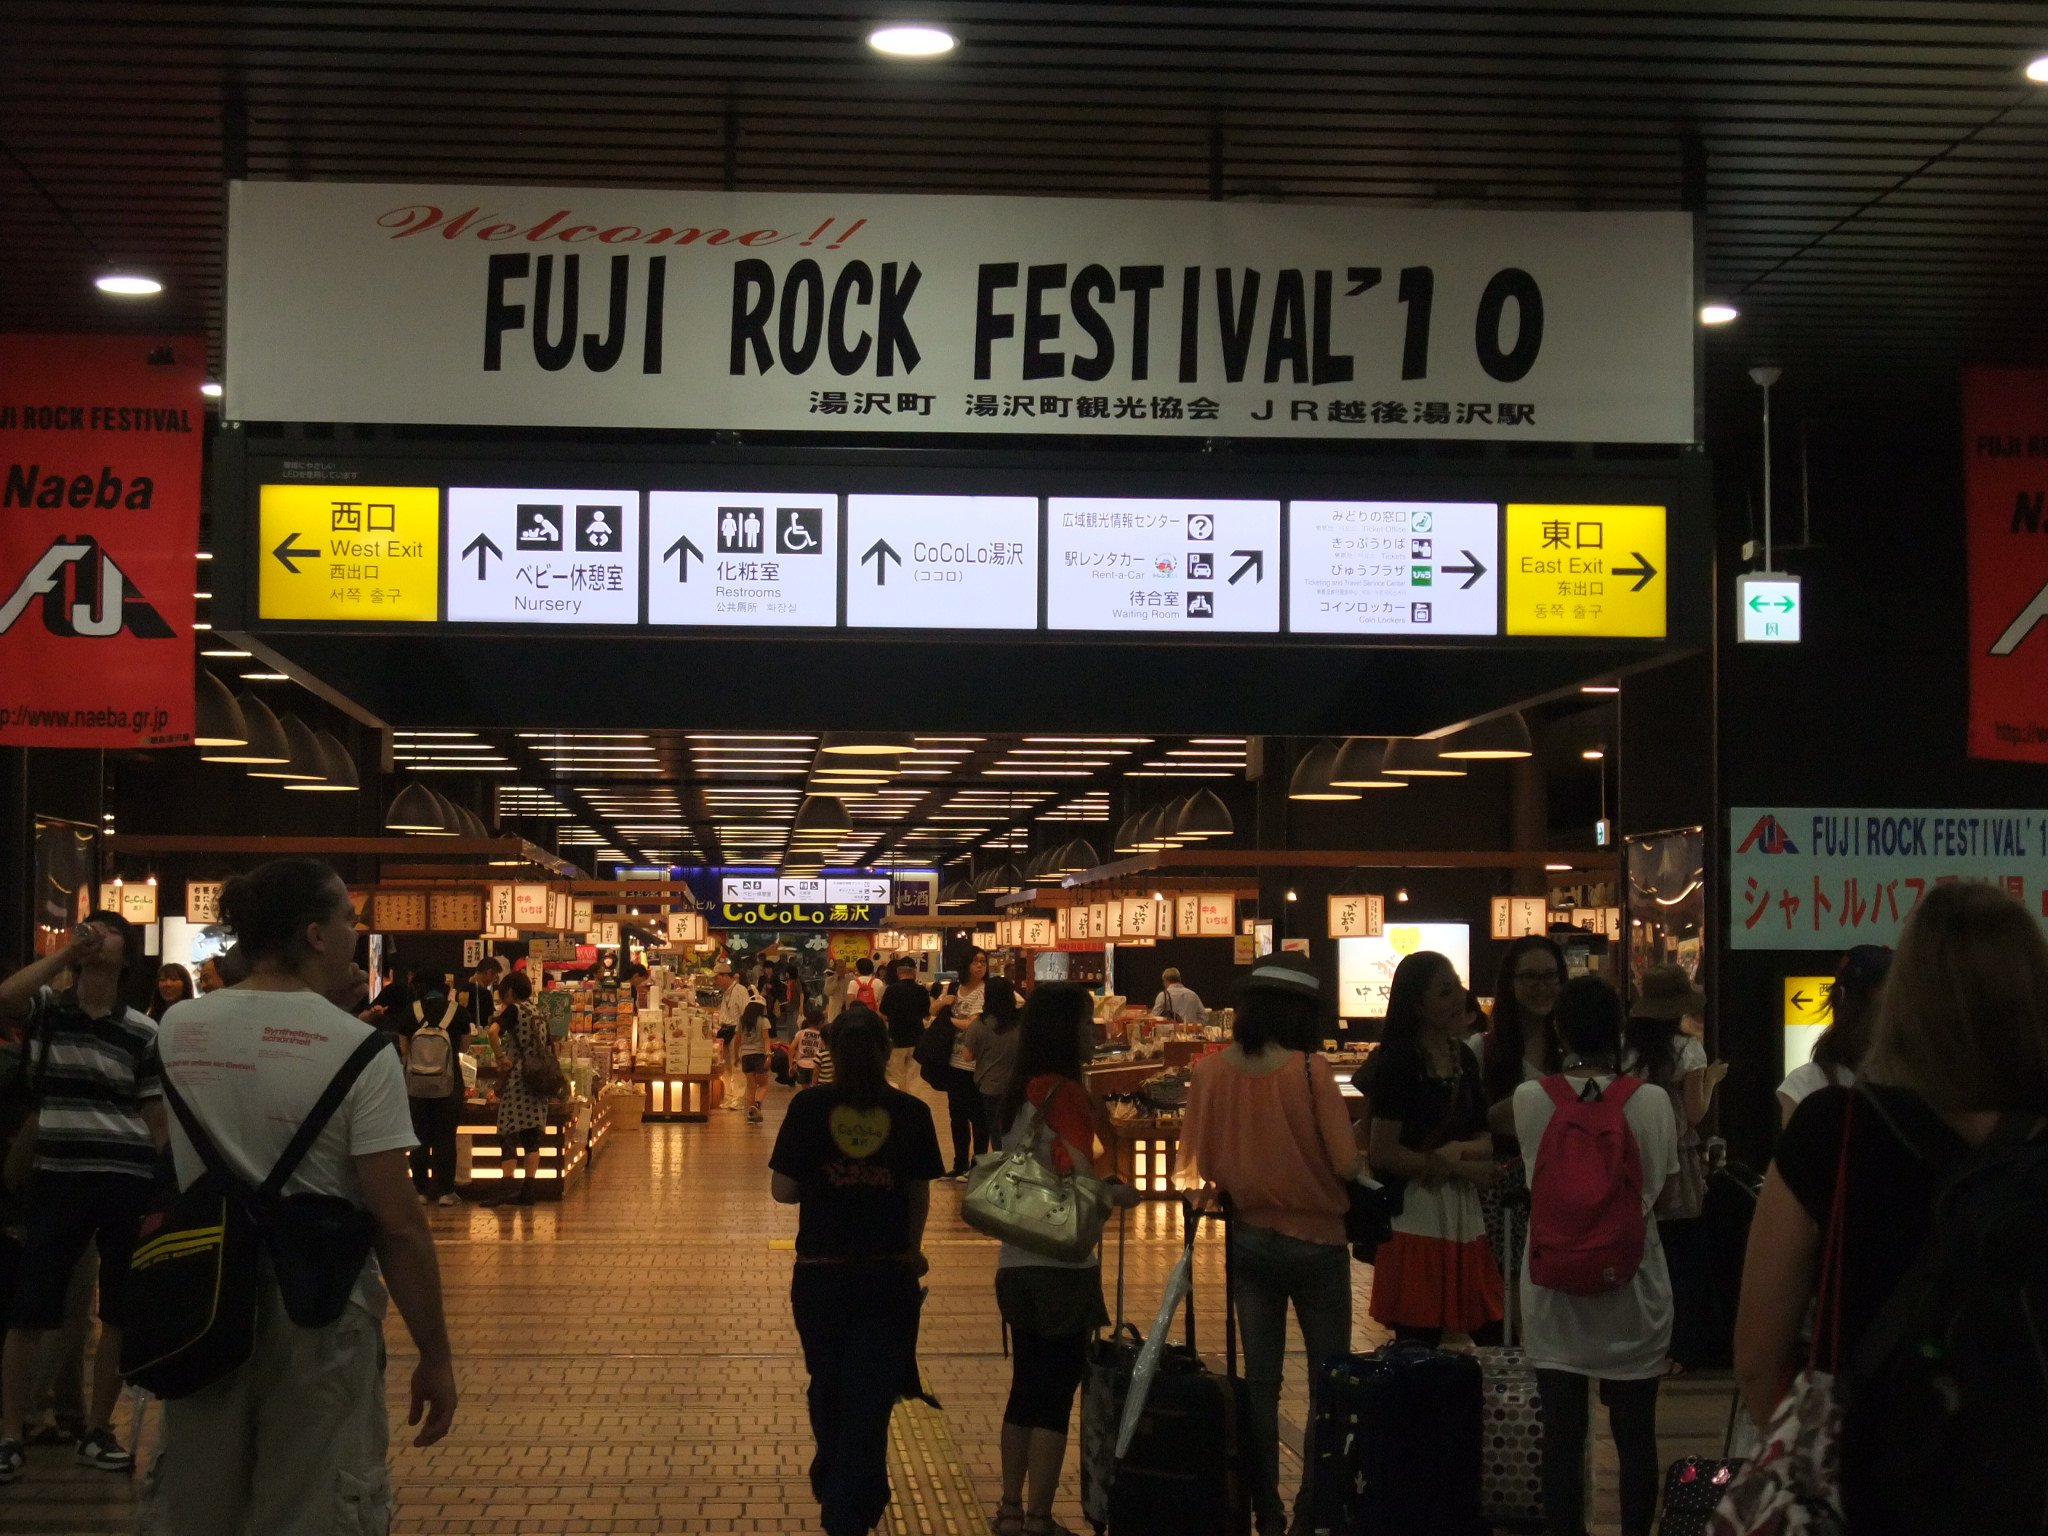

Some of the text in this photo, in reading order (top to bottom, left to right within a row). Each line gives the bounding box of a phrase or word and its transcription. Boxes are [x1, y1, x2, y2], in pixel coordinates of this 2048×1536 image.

[483, 253, 666, 374] FUJI
[729, 259, 922, 377] ROCK
[808, 391, 936, 416] 湯沢町
[965, 394, 1220, 419] 湯沢町観光協会
[24, 407, 84, 431] ROCK
[92, 408, 192, 432] FESTIVAL
[2, 464, 154, 510] Naeba
[331, 502, 395, 532] 西口
[1332, 510, 1407, 523] みどりの窓口
[2010, 490, 2048, 534] N
[1062, 512, 1181, 529] 広域観光情報センター
[1541, 519, 1603, 550] 東口
[330, 540, 423, 558] West Exit
[1331, 538, 1405, 550] きっぷうりば
[1064, 551, 1146, 567] 駅レンタカー
[1521, 557, 1603, 574] East Exit
[330, 564, 379, 579] 西出口
[516, 563, 624, 591] ベビー休憩室
[716, 561, 780, 582] 化粧室
[1092, 570, 1145, 580] Rent-a-Car
[1331, 564, 1405, 577] びゅうプラザ
[1413, 570, 1431, 579] びゅう
[330, 588, 402, 603] 서쪽 출구
[715, 586, 781, 598] Restrooms
[1557, 580, 1604, 596] 东出口
[514, 596, 582, 615] Nursery
[1129, 590, 1180, 607] 待合室
[1112, 609, 1180, 620] Waiting Room
[1319, 601, 1405, 613] コインロッカー
[1534, 604, 1603, 619] 동쪽 출구
[1812, 816, 1860, 857] FUJI
[1867, 817, 1927, 857] ROCK
[1202, 905, 1217, 914] 中央
[1206, 917, 1229, 925] いちば
